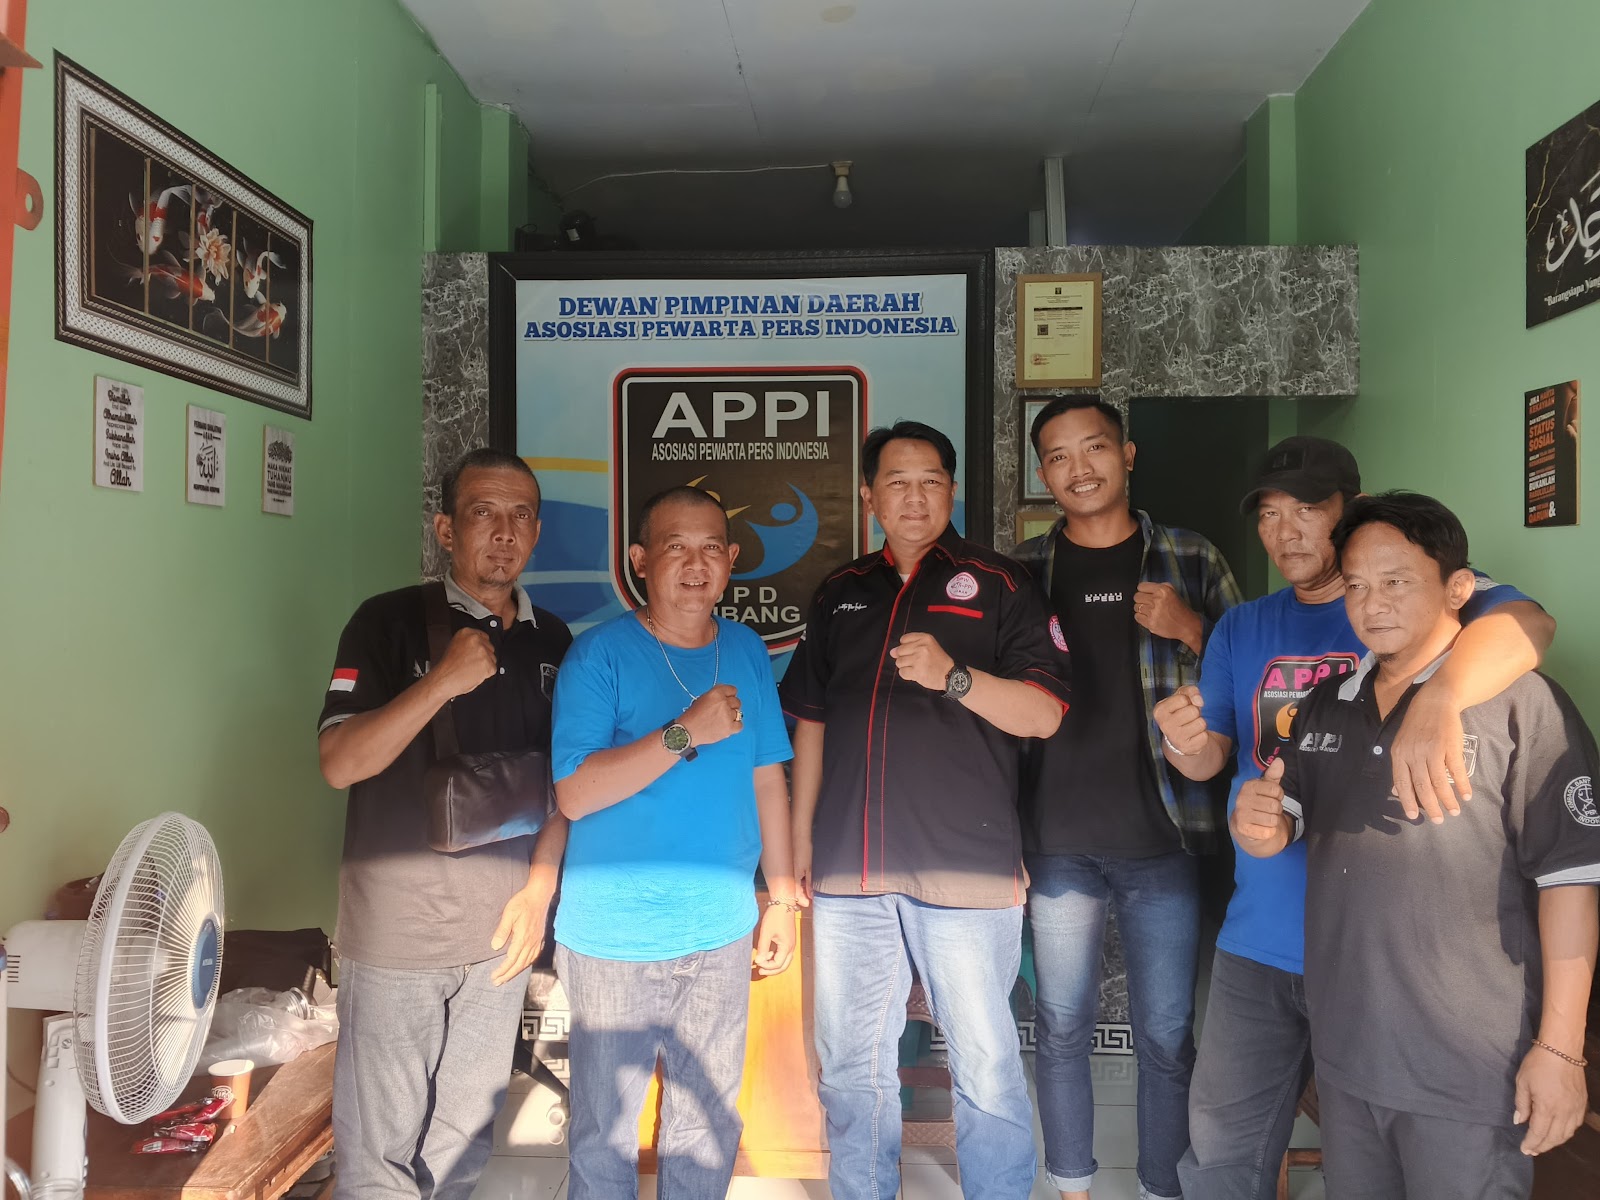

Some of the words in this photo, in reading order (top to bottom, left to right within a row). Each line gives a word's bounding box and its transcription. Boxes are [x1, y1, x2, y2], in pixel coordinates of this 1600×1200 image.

[558, 297, 658, 316] DEWAN
[664, 295, 800, 315] PIMPINAN
[807, 292, 921, 313] DAERAH
[523, 321, 637, 338] ASOSIASI
[641, 319, 756, 337] PEWARTA
[761, 319, 820, 336] PERS
[825, 316, 956, 335] INDONESIA
[652, 390, 830, 439] APPI
[1529, 417, 1555, 438] STATUS
[652, 442, 697, 461] ASOSIASI
[699, 442, 746, 461] PEWARTA
[748, 442, 774, 460] PERS
[776, 441, 830, 460] INDONESIA
[1529, 431, 1555, 452] SOSIAL
[110, 468, 131, 487] Allah
